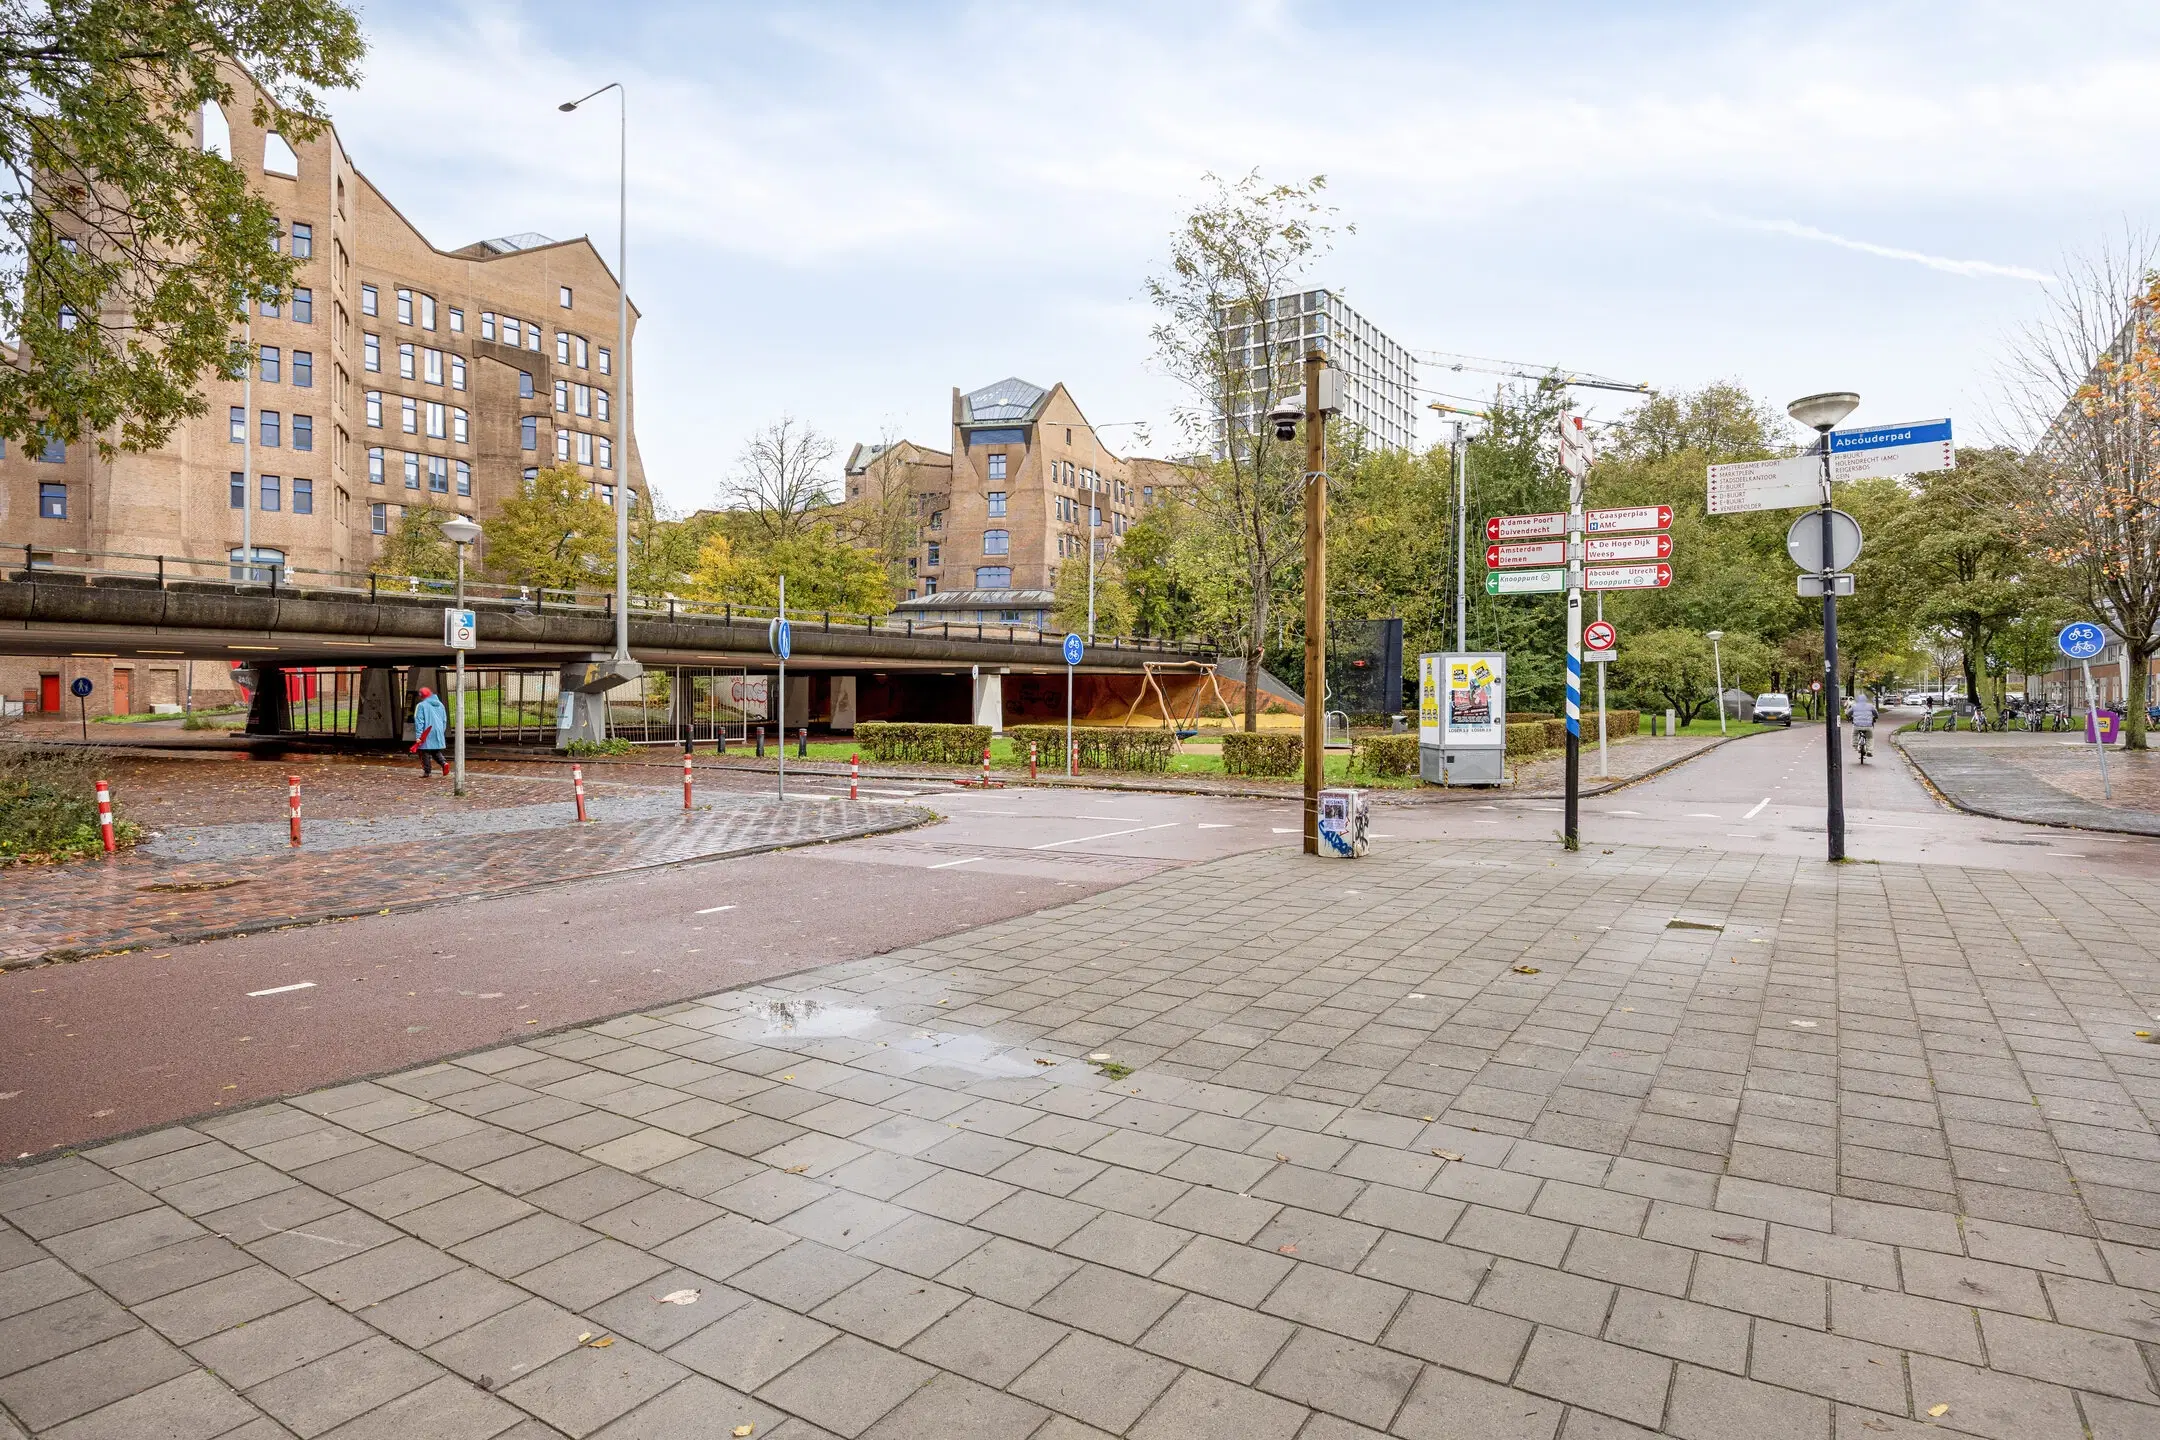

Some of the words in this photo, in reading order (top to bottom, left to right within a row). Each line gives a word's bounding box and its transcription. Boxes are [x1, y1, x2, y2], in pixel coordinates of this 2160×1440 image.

[1835, 431, 1911, 447] Abcouderpad
[1835, 452, 1863, 460] H-BUURT
[1835, 457, 1879, 467] HOLENDRECHT
[1720, 463, 1759, 471] AMSTERDAMSE
[1835, 465, 1871, 473] REIGERSBOS
[1720, 474, 1777, 484] STADSDEELKANTOOR
[1599, 510, 1648, 519] Gaasperplas
[1500, 527, 1550, 535] Duivendrecht
[1634, 539, 1650, 547] Dijk
[1589, 578, 1631, 586] Knooppunt
